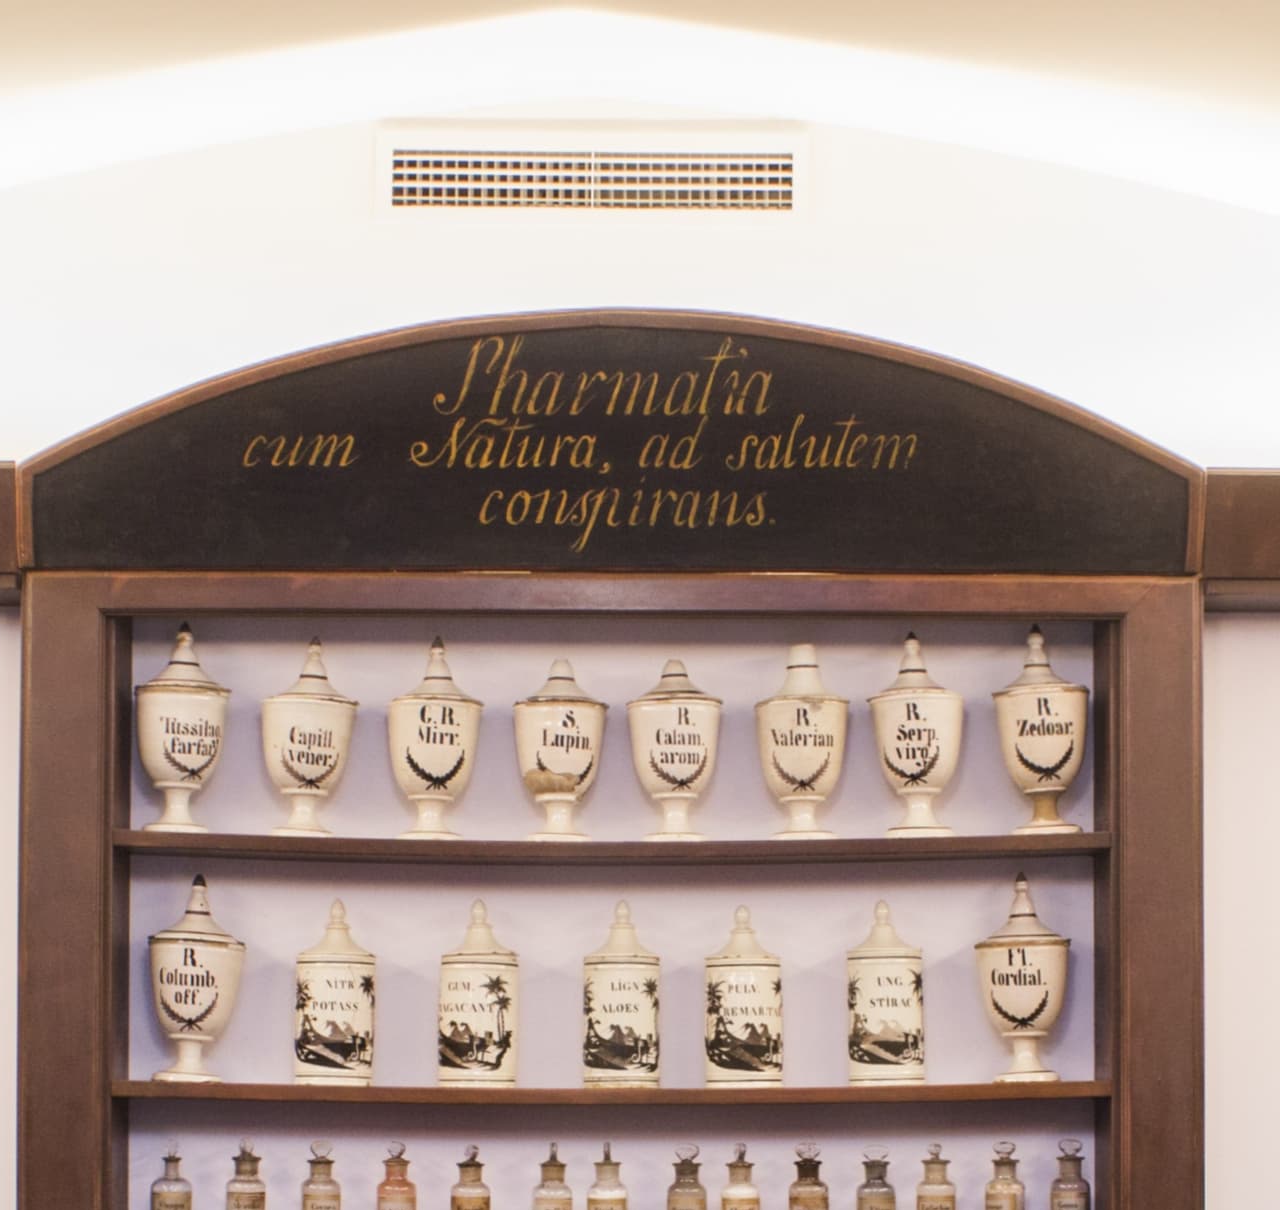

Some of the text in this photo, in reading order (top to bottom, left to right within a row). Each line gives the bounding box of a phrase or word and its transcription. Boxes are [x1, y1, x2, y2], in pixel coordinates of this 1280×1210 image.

[242, 413, 919, 475] cum Natura, ad salutem
[479, 476, 776, 553] conspirans.
[439, 706, 458, 726] R.
[676, 706, 695, 728] R.
[794, 707, 815, 728] R.
[905, 702, 926, 722] R.
[1036, 697, 1059, 717] R.
[770, 727, 833, 749] Valerian
[183, 947, 204, 968] R.
[602, 1002, 640, 1014] ALOES
